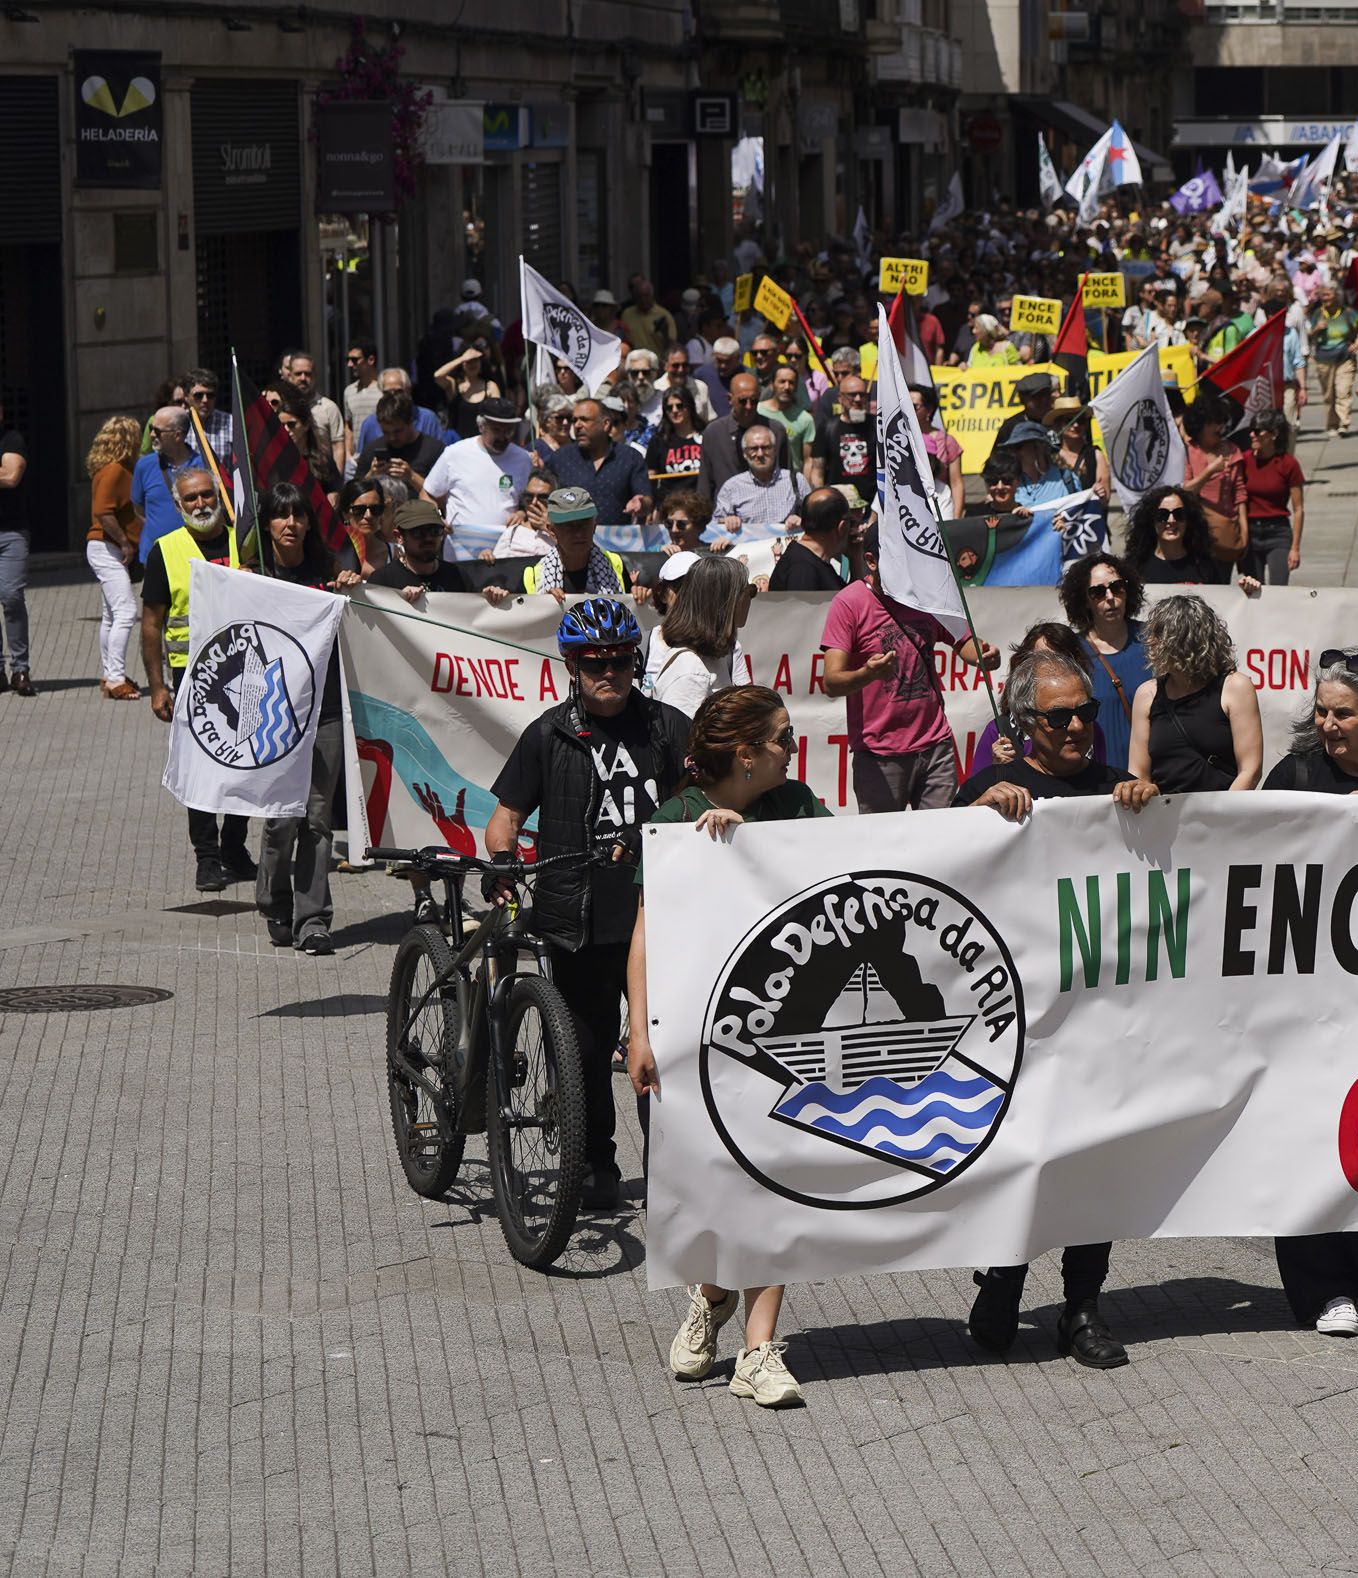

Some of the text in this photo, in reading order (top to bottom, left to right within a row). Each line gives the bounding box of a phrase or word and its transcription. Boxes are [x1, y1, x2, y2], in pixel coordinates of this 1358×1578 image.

[81, 125, 159, 142] HELADERÍA
[886, 263, 923, 275] ALTRI
[1085, 276, 1118, 287] ENCE
[1085, 288, 1119, 299] FÓRA
[1019, 300, 1055, 313] ENCE
[1018, 311, 1053, 325] FÓRA
[946, 414, 1008, 433] PÚBLIC
[430, 652, 525, 701] DENDE
[538, 658, 559, 702] A
[1246, 648, 1310, 690] SON
[1057, 867, 1191, 992] NIN
[712, 885, 1018, 1057] Pola Defensa da RIA
